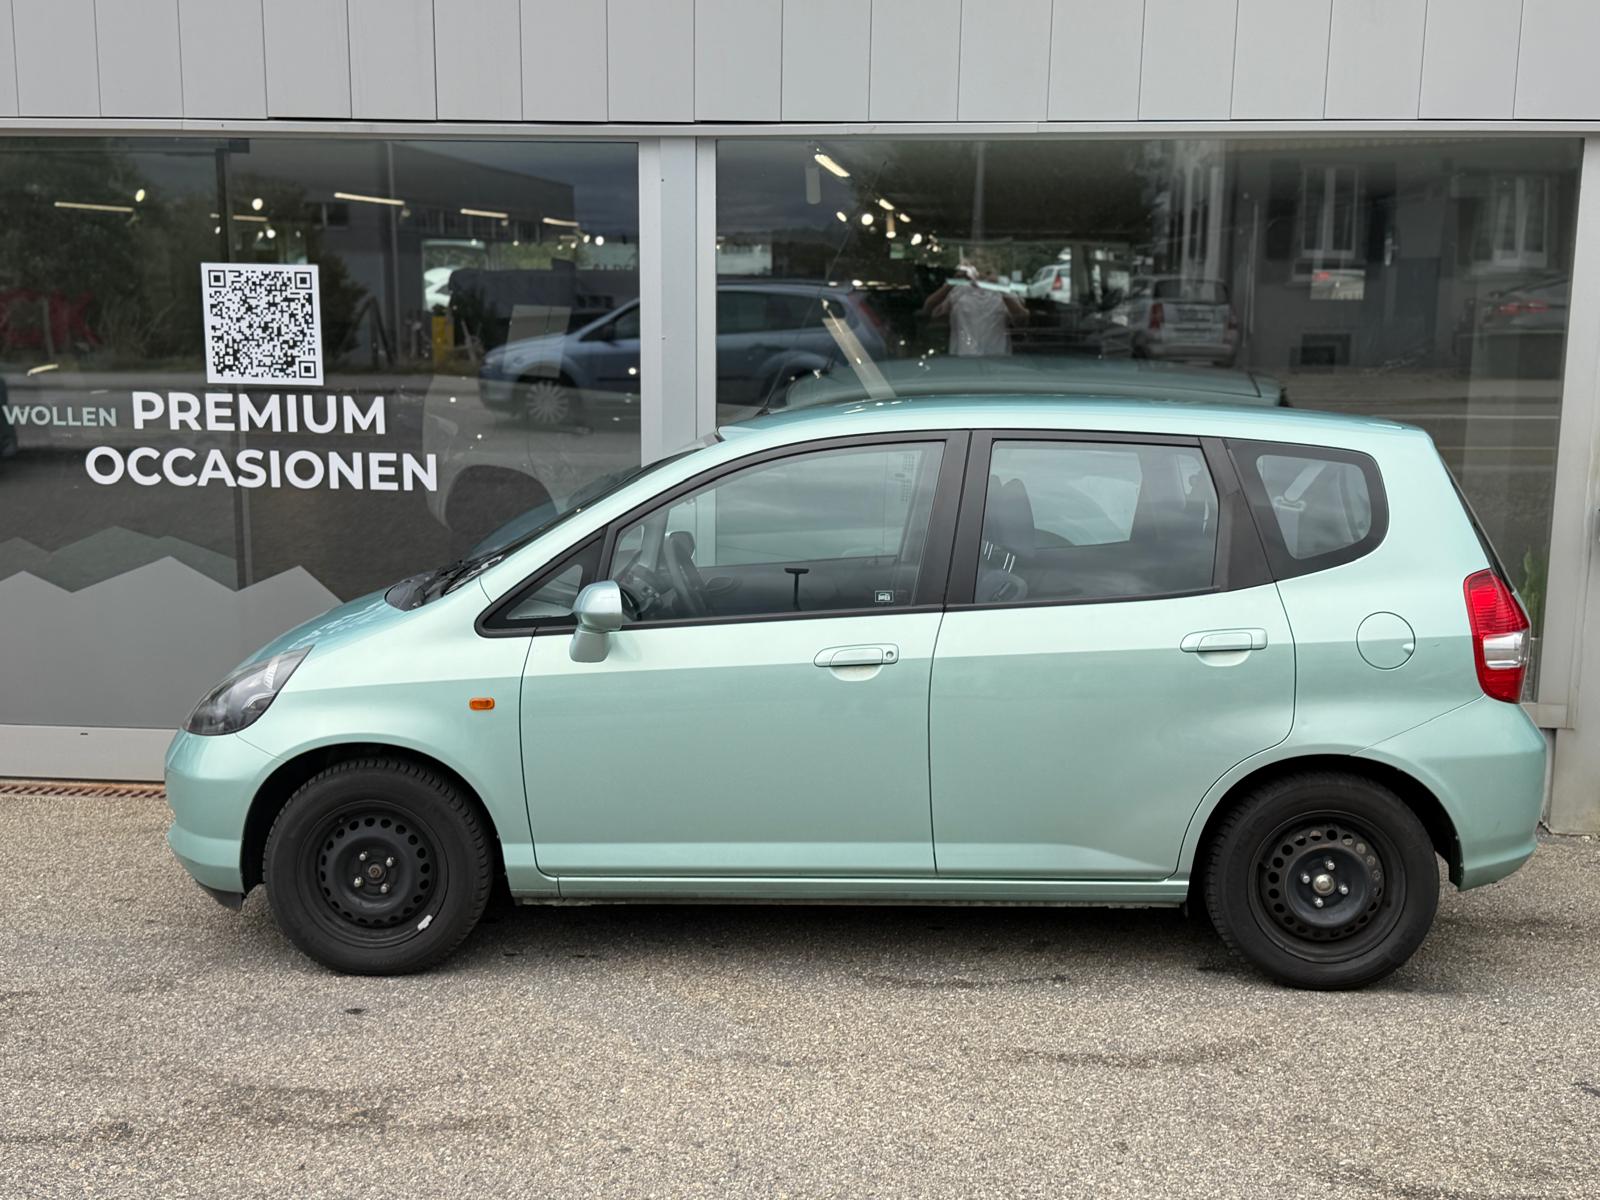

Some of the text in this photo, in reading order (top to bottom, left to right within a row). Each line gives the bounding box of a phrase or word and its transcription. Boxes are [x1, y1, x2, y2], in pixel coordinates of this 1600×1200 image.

[2, 405, 118, 427] WOLLEN
[132, 392, 386, 434] PREMIUM
[85, 446, 438, 491] OCCASIONEN
